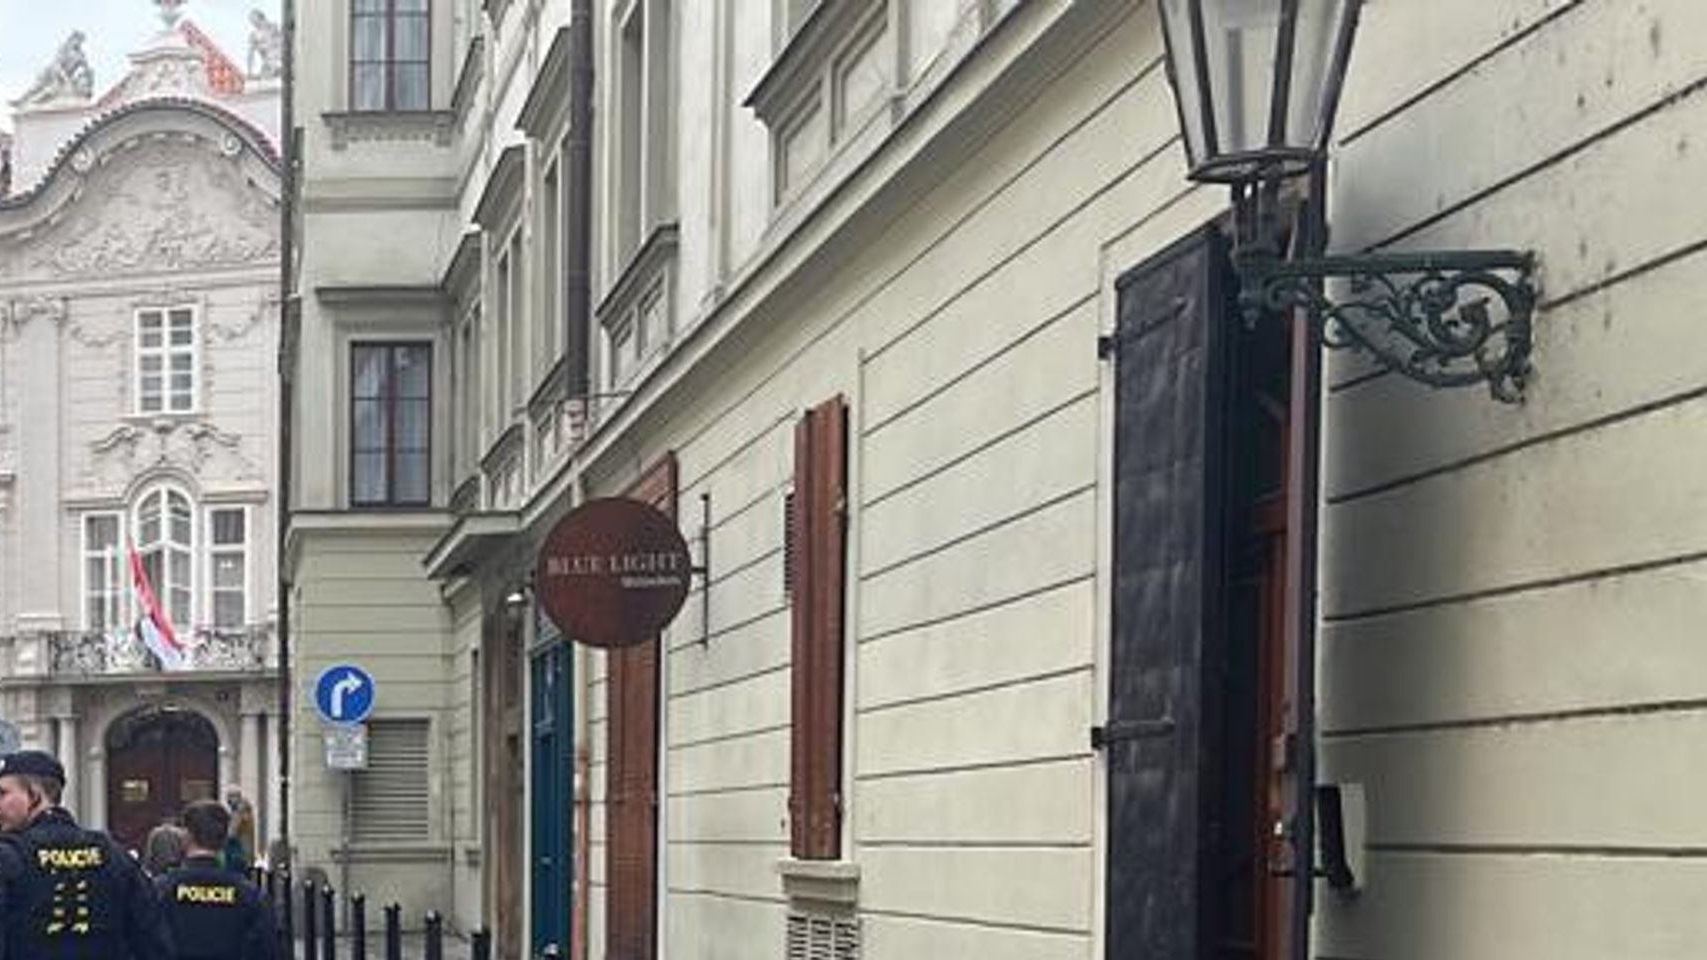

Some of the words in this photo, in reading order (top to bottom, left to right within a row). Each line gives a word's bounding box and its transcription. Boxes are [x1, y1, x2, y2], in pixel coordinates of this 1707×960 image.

[547, 556, 601, 575] BLUE
[610, 552, 682, 572] LIGHT
[37, 846, 102, 867] POLICIE
[176, 885, 235, 903] POLICIE
